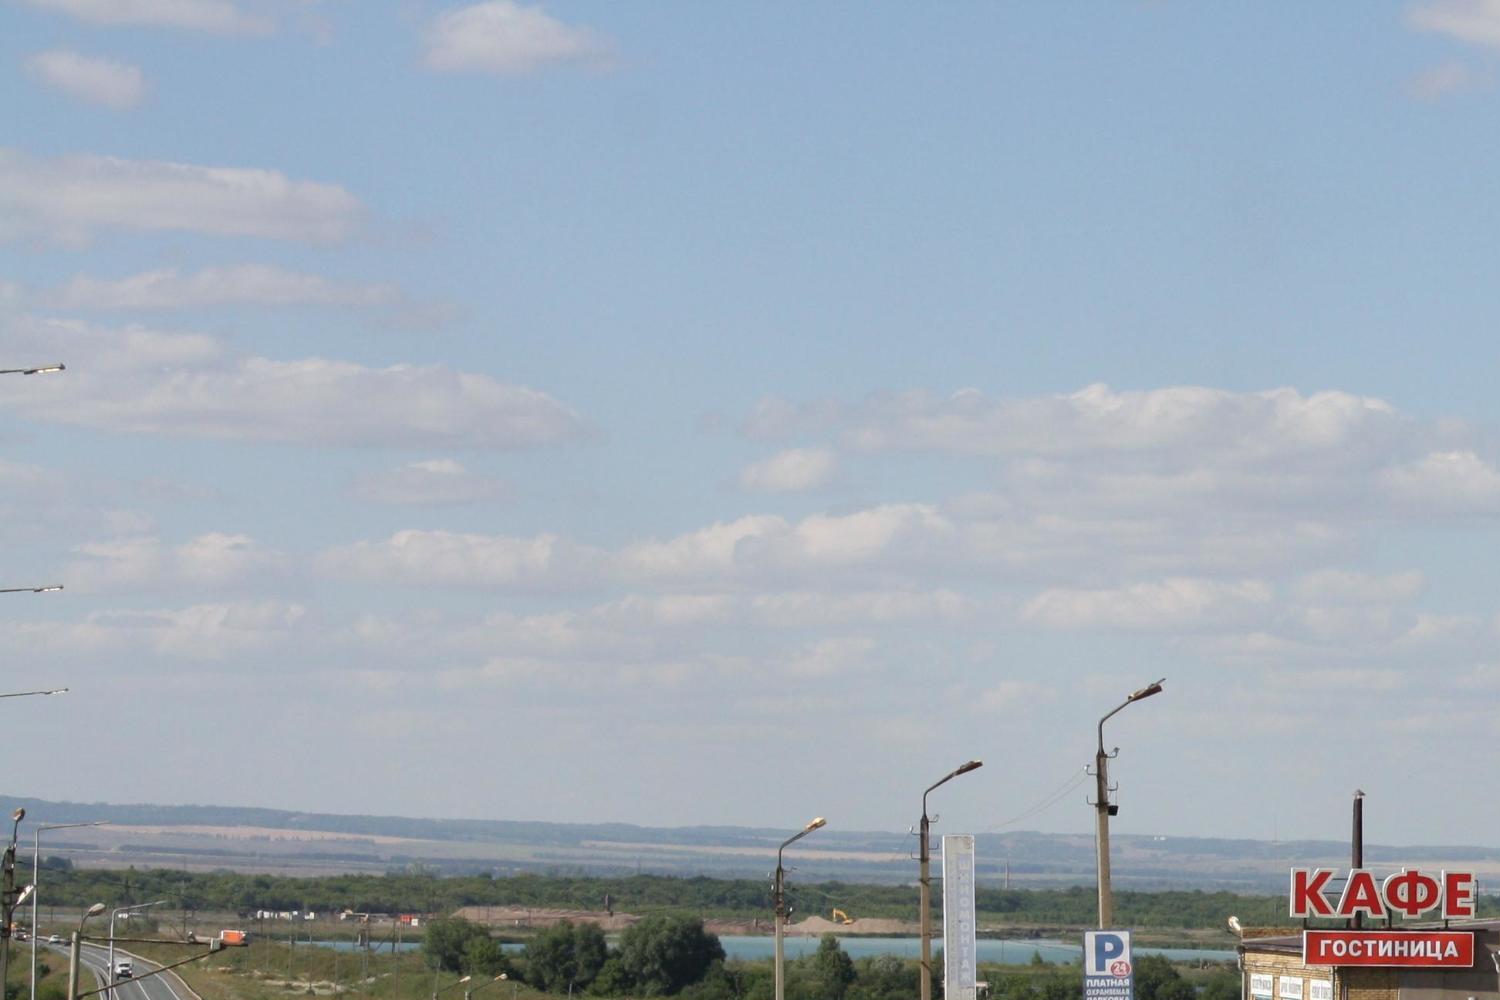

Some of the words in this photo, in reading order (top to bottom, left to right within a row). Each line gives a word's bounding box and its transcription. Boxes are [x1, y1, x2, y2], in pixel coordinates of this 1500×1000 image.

[1290, 867, 1475, 919] КАФЕ
[1319, 939, 1459, 960] ГОСТИНИЦА
[1086, 978, 1130, 988] ПЛАТНАЯ
